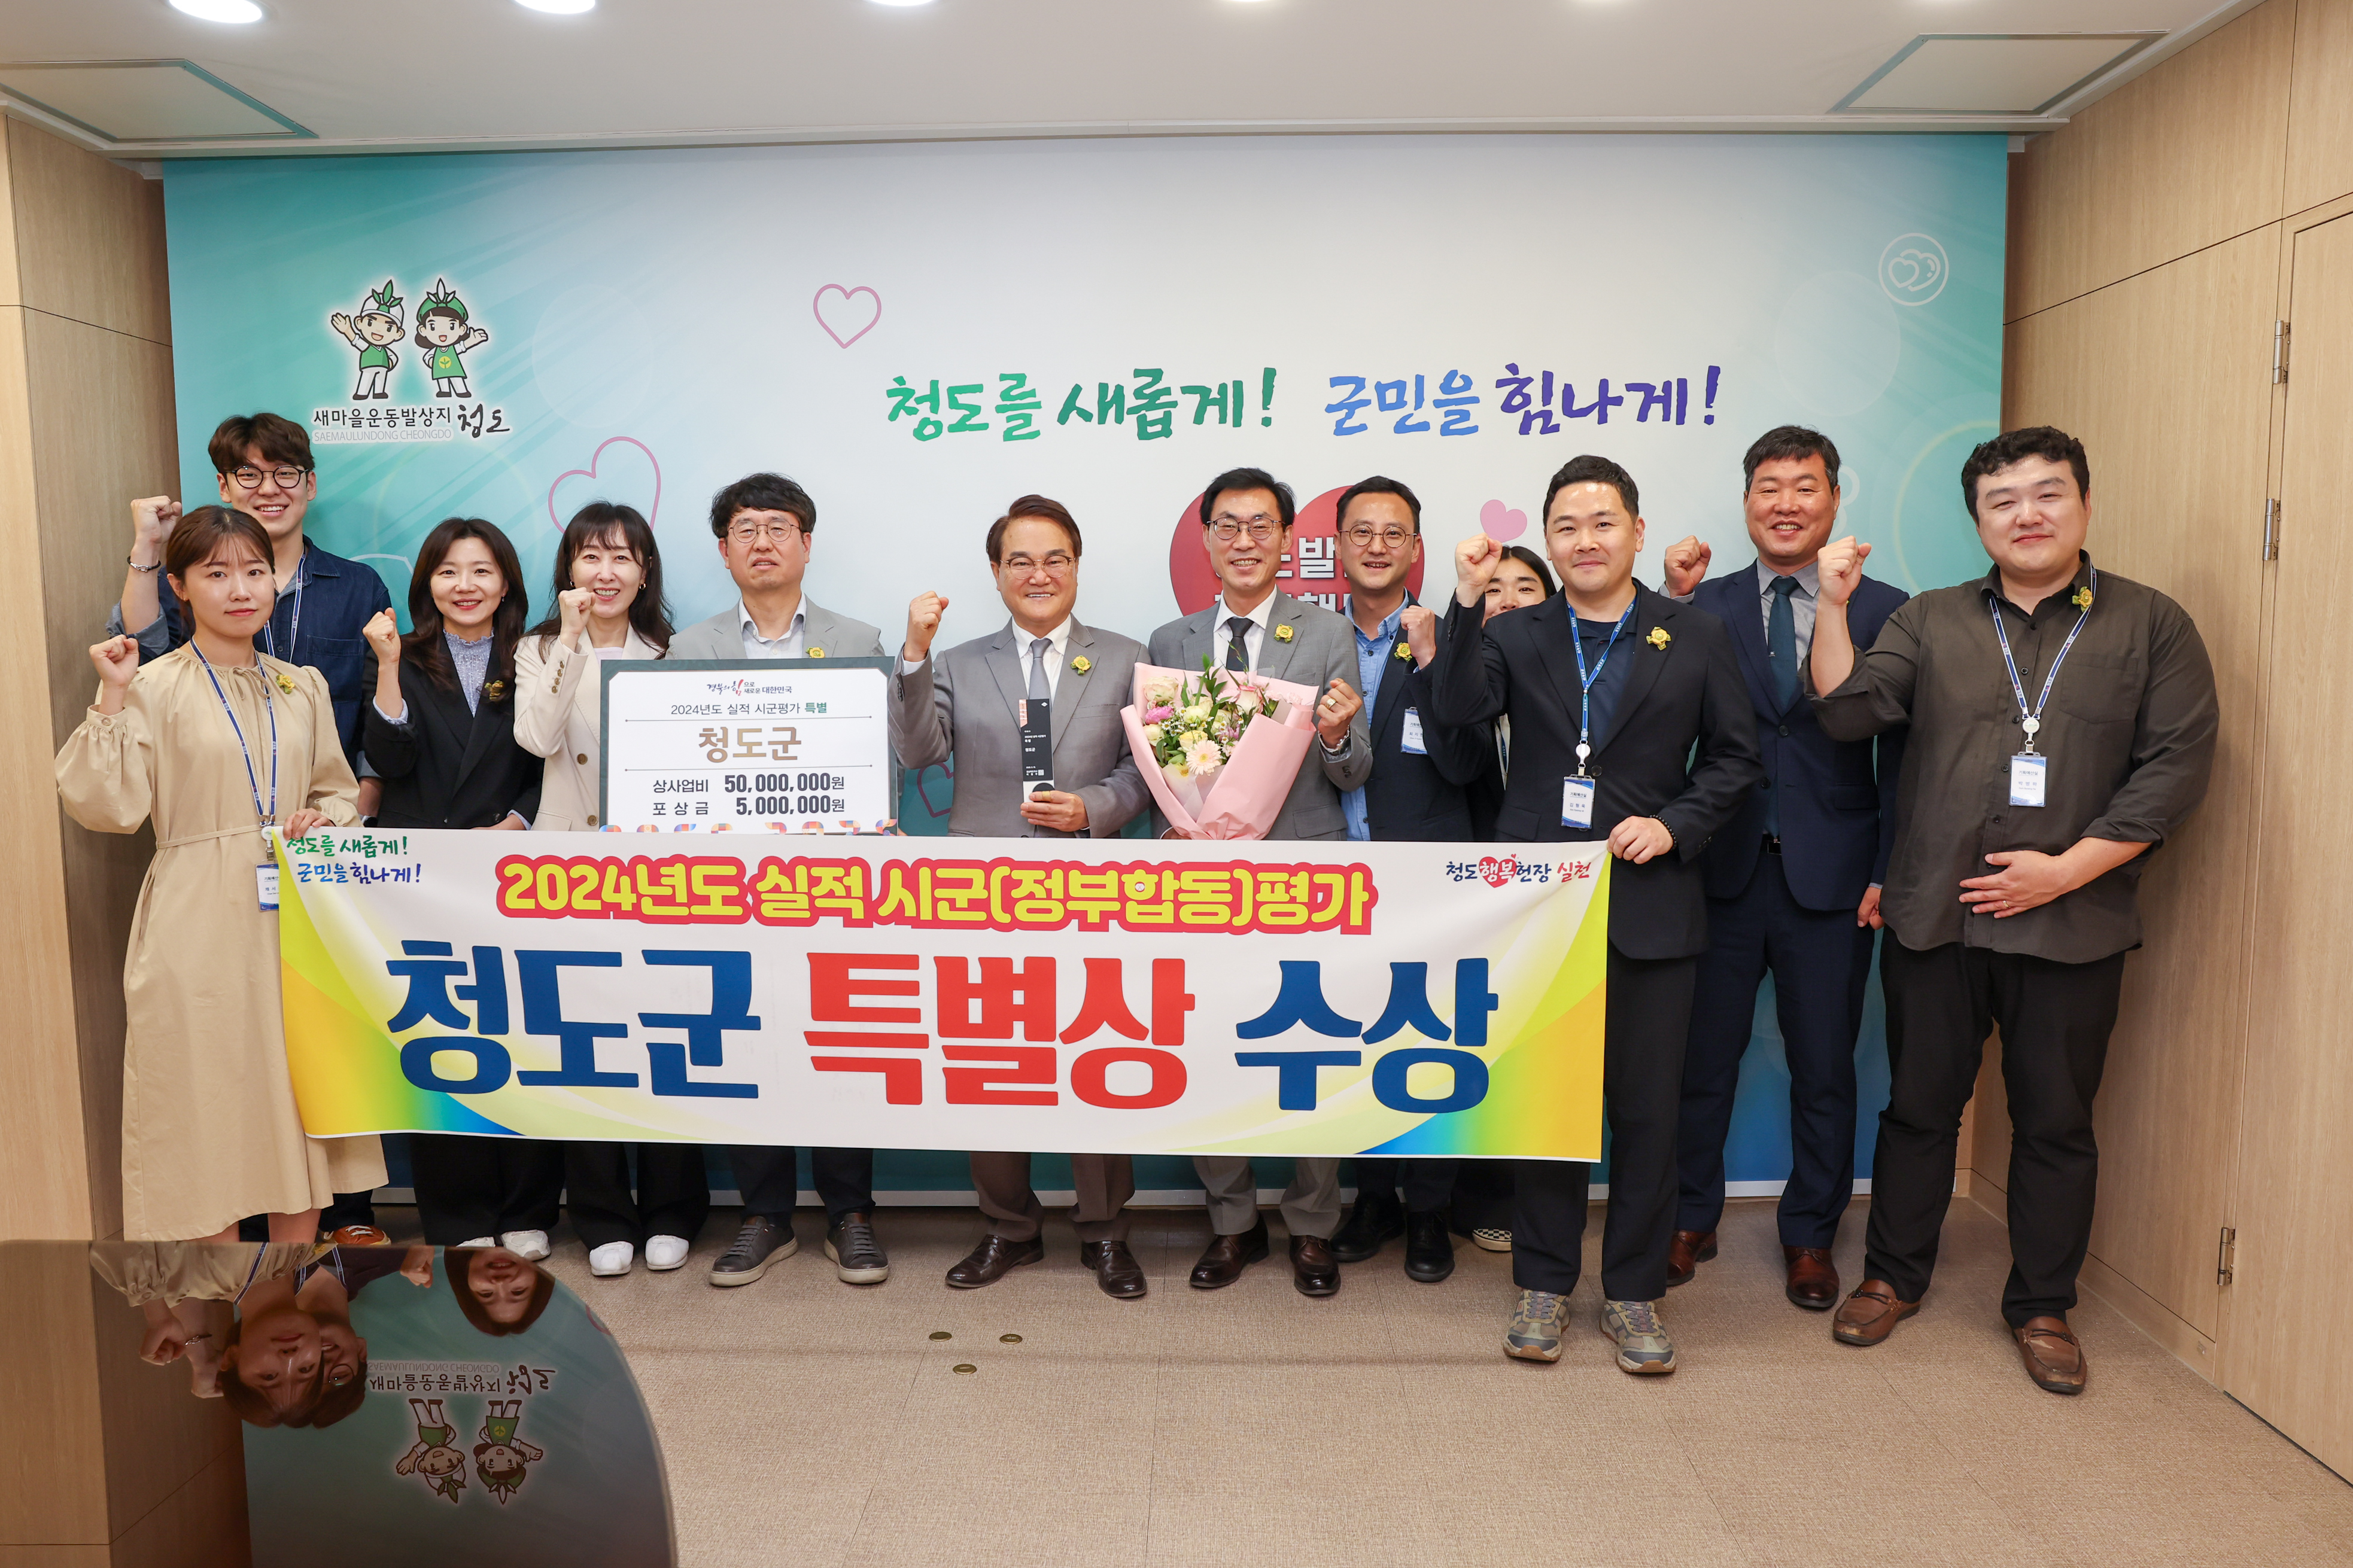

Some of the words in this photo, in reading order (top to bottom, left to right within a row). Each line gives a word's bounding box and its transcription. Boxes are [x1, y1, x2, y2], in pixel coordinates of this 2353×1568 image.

[886, 373, 1042, 442] 청도를
[1057, 367, 1276, 440] 새롭게!
[1325, 369, 1480, 437] 군민을
[1495, 363, 1720, 436] 힘나게!
[314, 407, 451, 428] 새마을운동발상지
[457, 403, 510, 439] 청도
[314, 430, 399, 442] SAEMAULUNDONG
[400, 428, 452, 440] CHEONGDO
[671, 704, 722, 715] 2024년도
[728, 704, 749, 714] 실적
[755, 703, 800, 714] 시군평가
[804, 702, 828, 714] 특별
[698, 726, 802, 763] 청도군
[652, 779, 709, 793] 상사업비
[725, 772, 844, 793] 50,000,000원
[736, 795, 844, 815] 5,000,000원
[287, 836, 335, 857] 청도를
[339, 835, 407, 858] 새롭게!
[297, 863, 349, 883] 군민을
[349, 861, 421, 884] 힘나게!
[1556, 861, 1592, 883] 실천
[501, 861, 746, 918] 2024년도
[755, 863, 862, 920] 실적
[877, 862, 1372, 928] 시군(정부합동)평가
[386, 939, 762, 1099] 청도군
[804, 952, 1196, 1110] 특별상
[1235, 957, 1499, 1114] 수상
